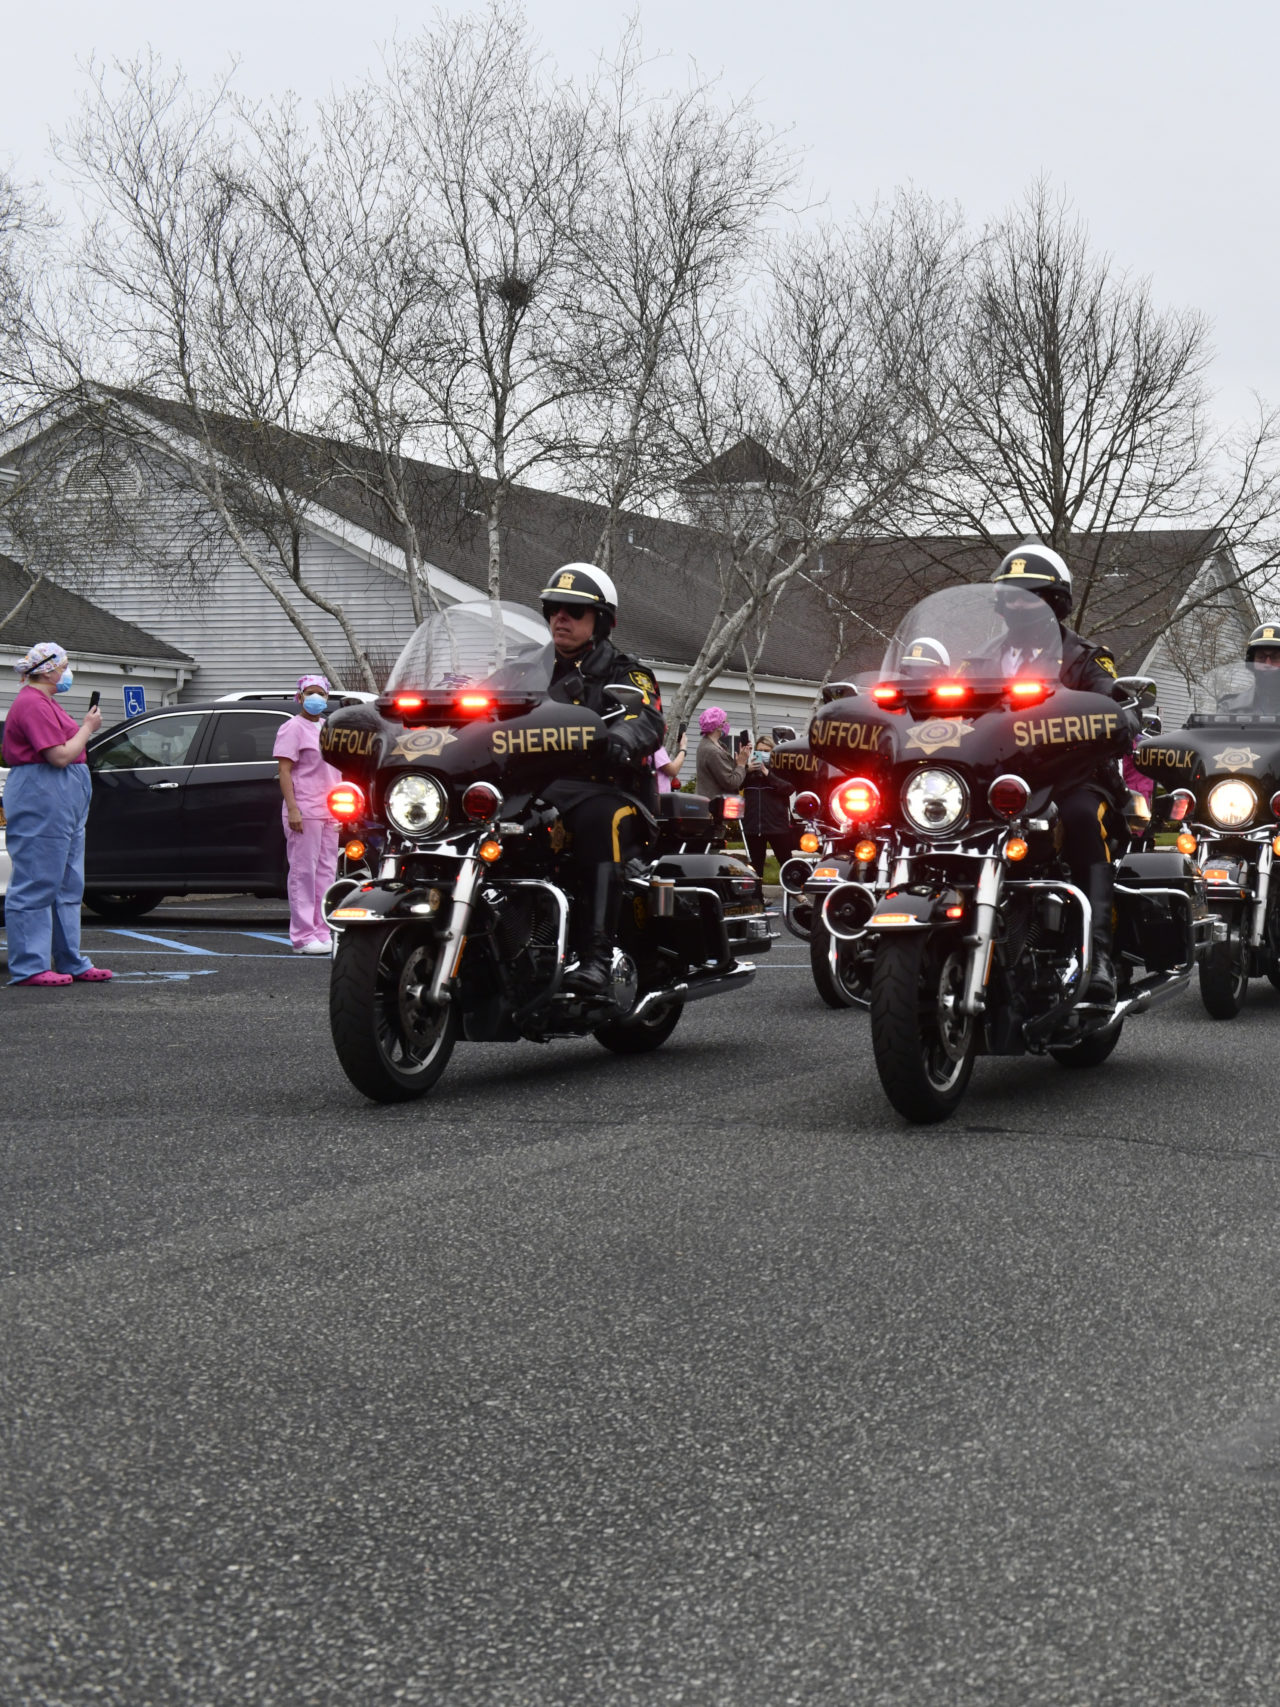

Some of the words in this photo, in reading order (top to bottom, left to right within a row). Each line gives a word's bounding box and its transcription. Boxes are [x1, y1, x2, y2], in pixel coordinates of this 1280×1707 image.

[322, 728, 376, 755] SUFFOLK
[492, 726, 596, 754] SHERIFF
[810, 720, 883, 751] SUFFOLK
[1013, 713, 1118, 747] SHERIFF
[770, 752, 819, 771] SUFFOLK
[1135, 747, 1195, 768] SUFFOLK
